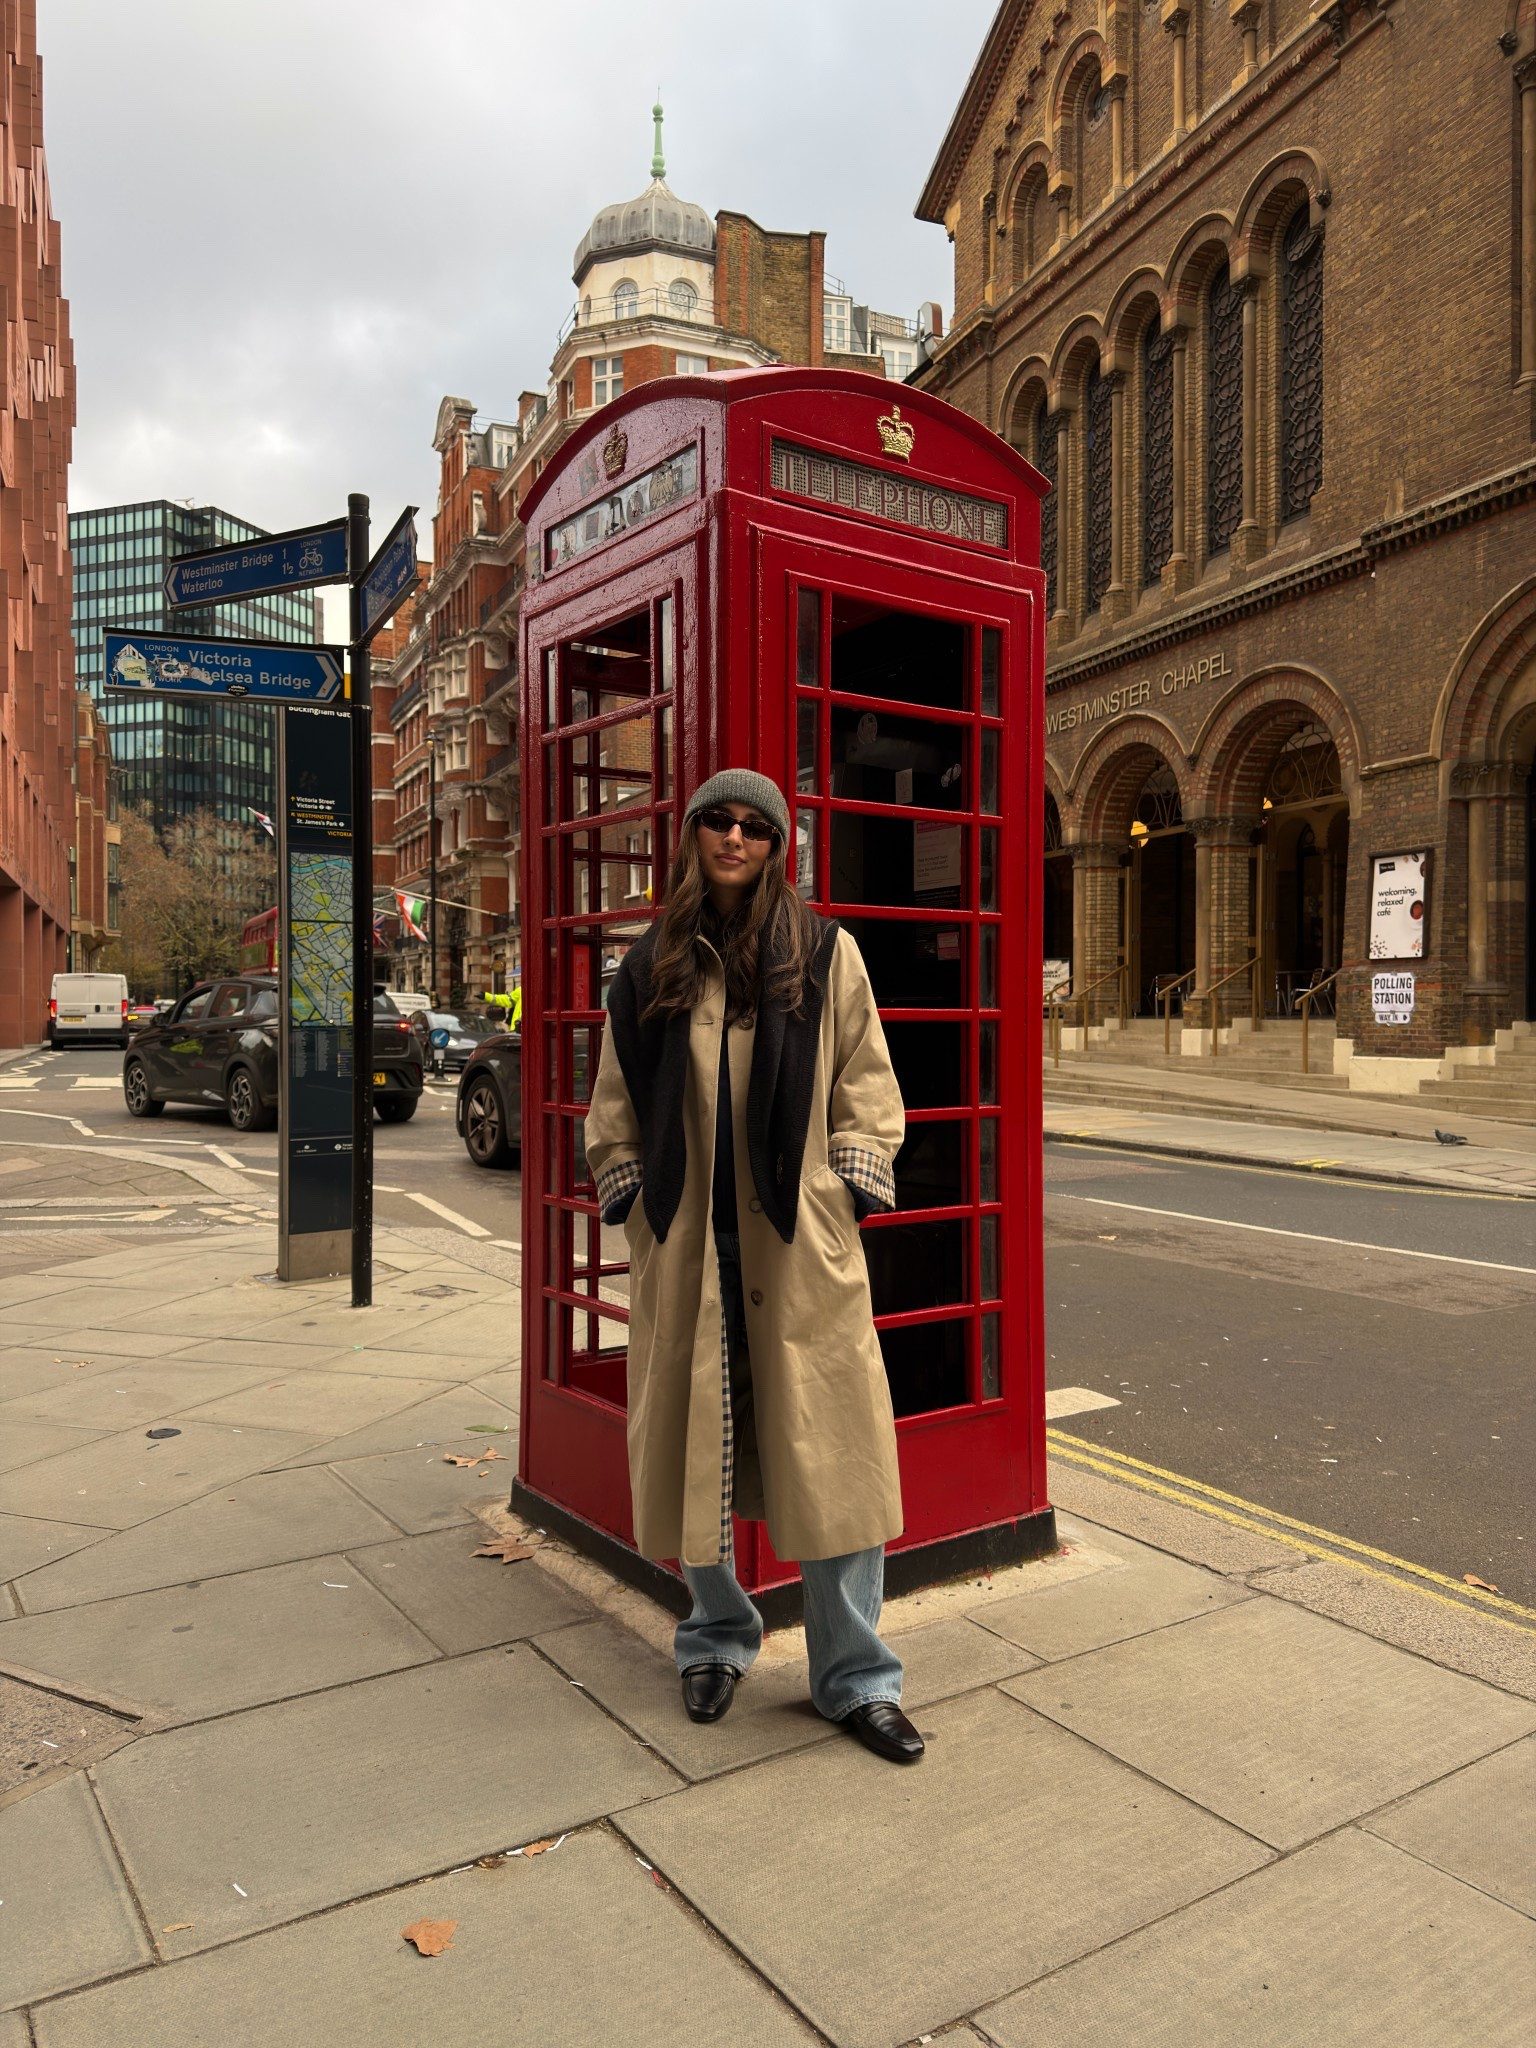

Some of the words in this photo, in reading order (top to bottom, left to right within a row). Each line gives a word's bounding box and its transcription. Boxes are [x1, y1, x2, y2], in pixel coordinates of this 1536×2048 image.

[777, 451, 997, 545] TELEPHONE
[300, 539, 322, 549] LONDON
[181, 560, 239, 580] Westminster
[242, 553, 274, 568] Bridge
[282, 547, 287, 560] 1
[298, 567, 323, 577] NETWORK
[181, 577, 223, 595] Waterloo
[144, 644, 179, 653] LONDON
[188, 649, 252, 667] Victoria
[191, 666, 253, 684] helsea
[260, 671, 312, 690] Bridge
[1045, 680, 1151, 735] WESTMINSTER
[1161, 652, 1232, 695] CHAPEL
[296, 812, 334, 820] WESTMINSTER
[1377, 896, 1404, 907] relaxed
[1376, 907, 1391, 917] café
[1374, 977, 1412, 990] POLLING
[1374, 992, 1412, 1004] STATION
[1379, 1013, 1391, 1021] WAY
